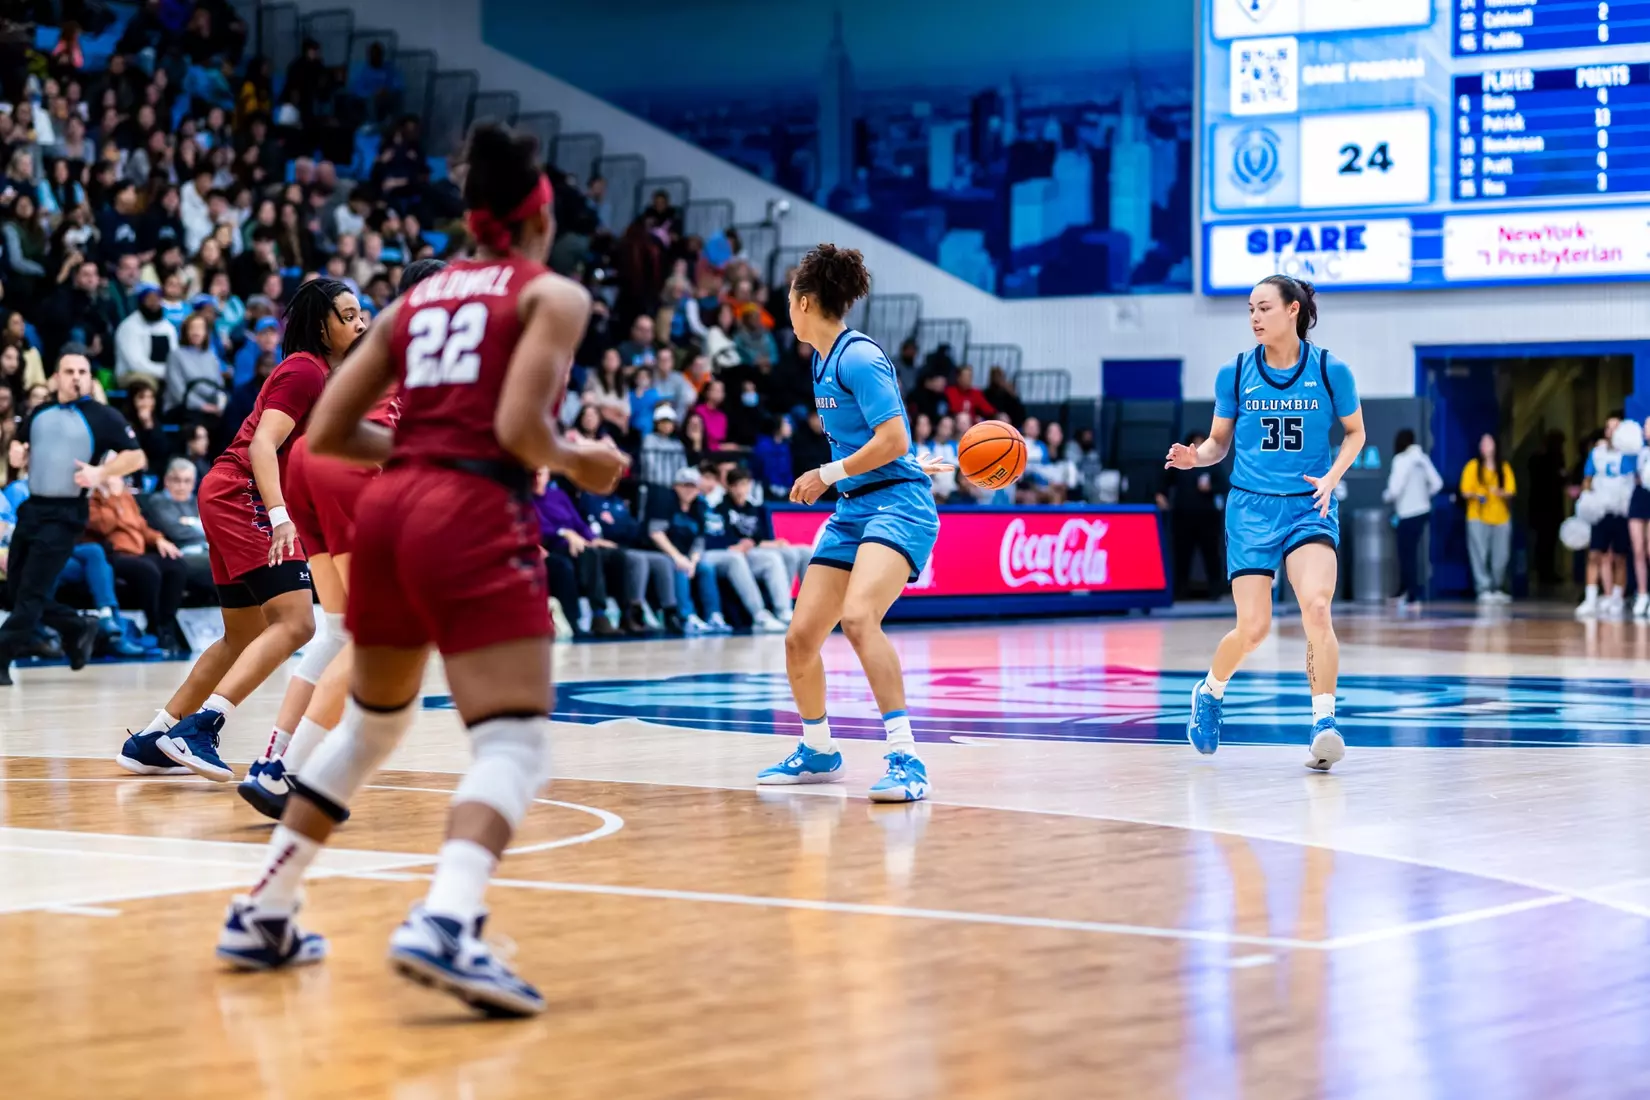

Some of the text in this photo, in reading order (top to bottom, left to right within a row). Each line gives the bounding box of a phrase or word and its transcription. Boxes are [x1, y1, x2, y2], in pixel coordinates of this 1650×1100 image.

[1482, 65, 1630, 91] PLAYER POINTS
[1483, 112, 1526, 132] Patrick
[1338, 141, 1394, 175] 24
[1245, 223, 1369, 256] SPARE
[1498, 243, 1623, 274] Presbyterian
[404, 302, 489, 389] 22
[1245, 399, 1319, 411] COLUMBIA
[1260, 416, 1304, 452] 35
